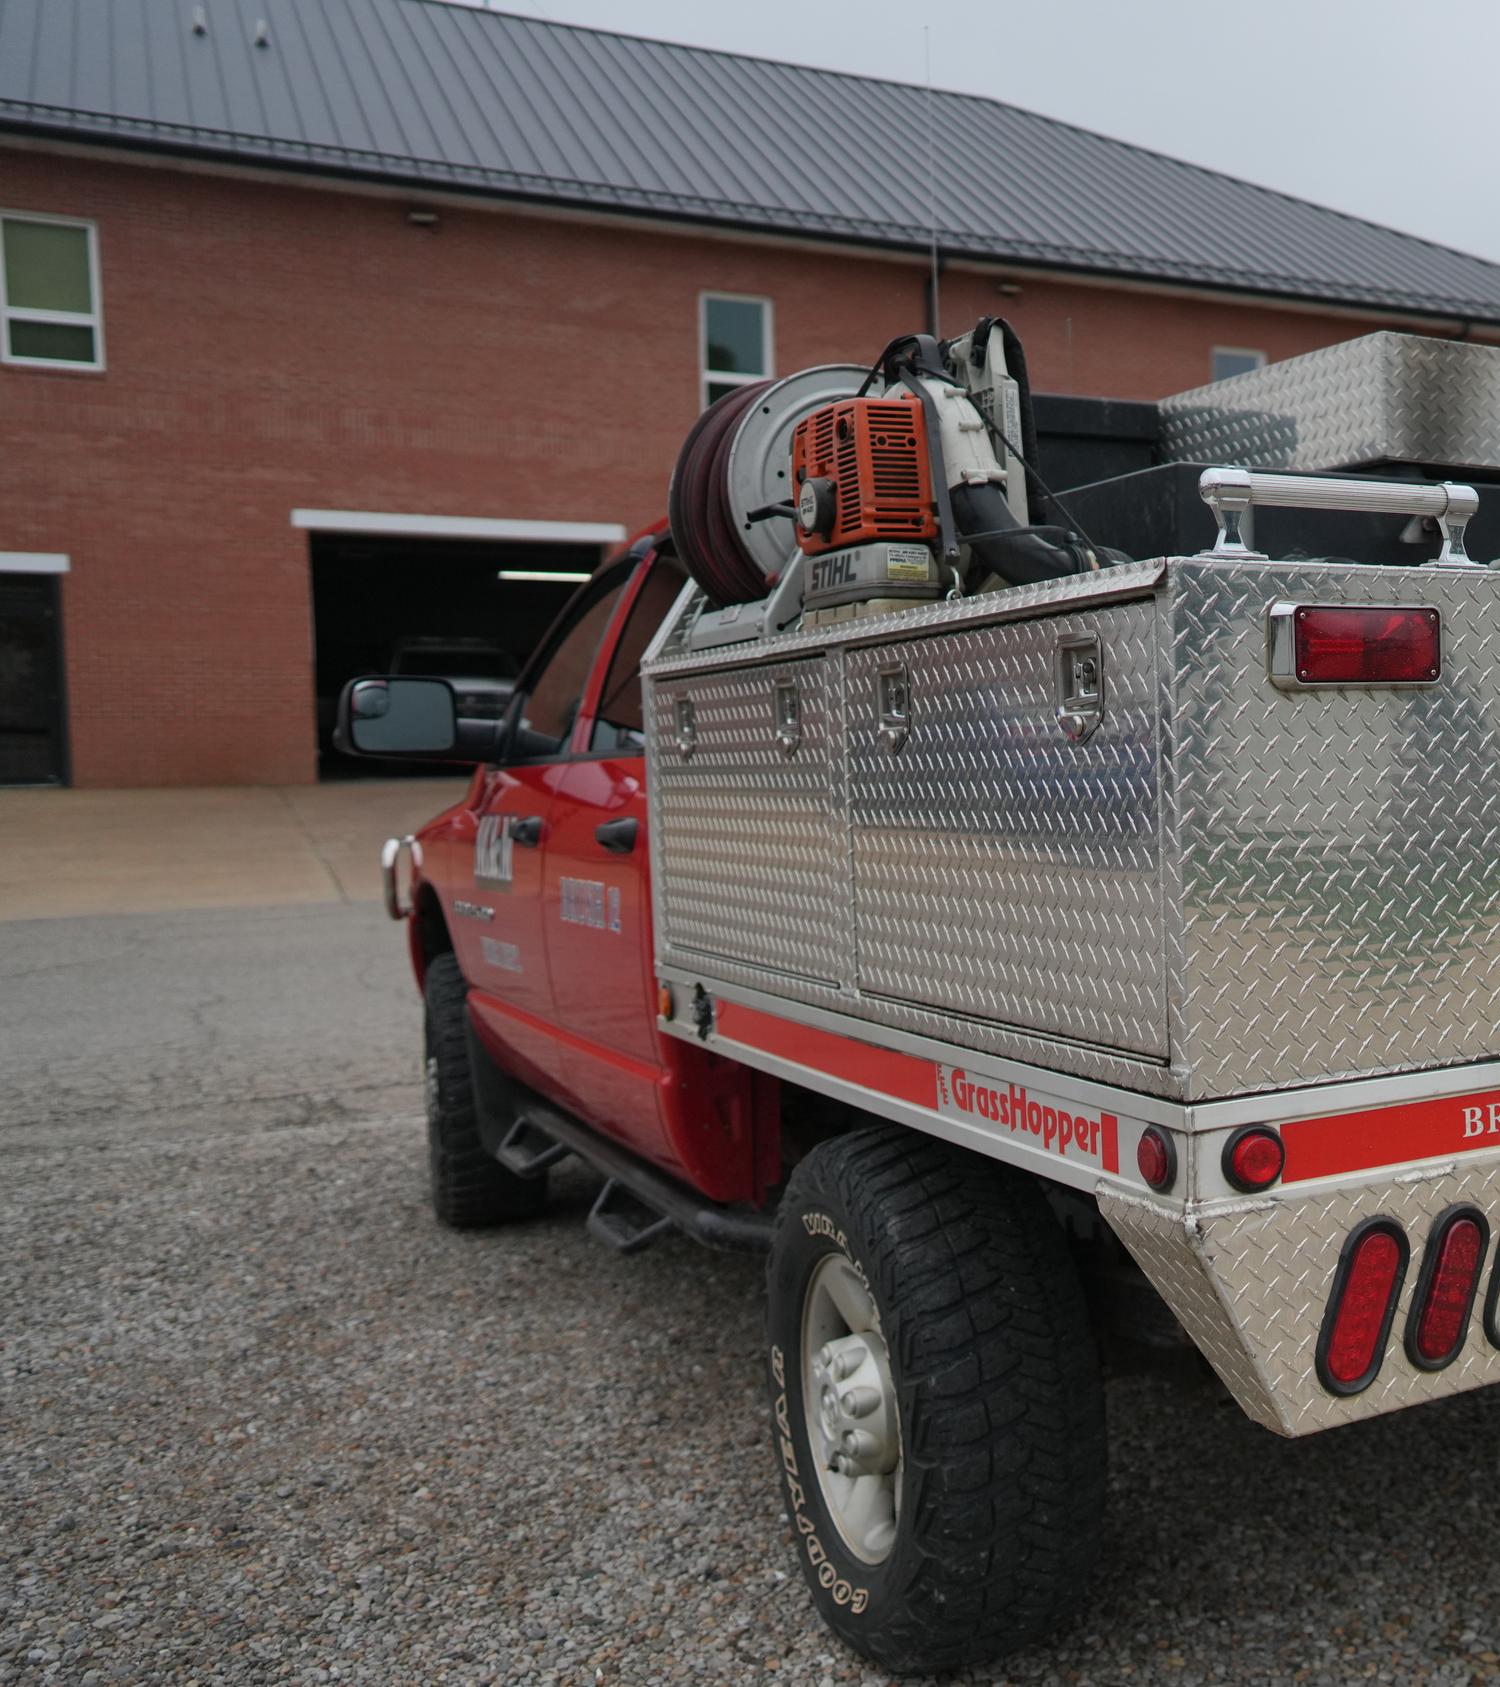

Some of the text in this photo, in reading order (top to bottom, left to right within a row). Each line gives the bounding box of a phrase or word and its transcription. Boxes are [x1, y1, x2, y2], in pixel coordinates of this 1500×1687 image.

[811, 553, 857, 590] STIHL
[951, 1068, 1100, 1155] GrassHopper
[770, 1343, 870, 1615] GOODYEAR
